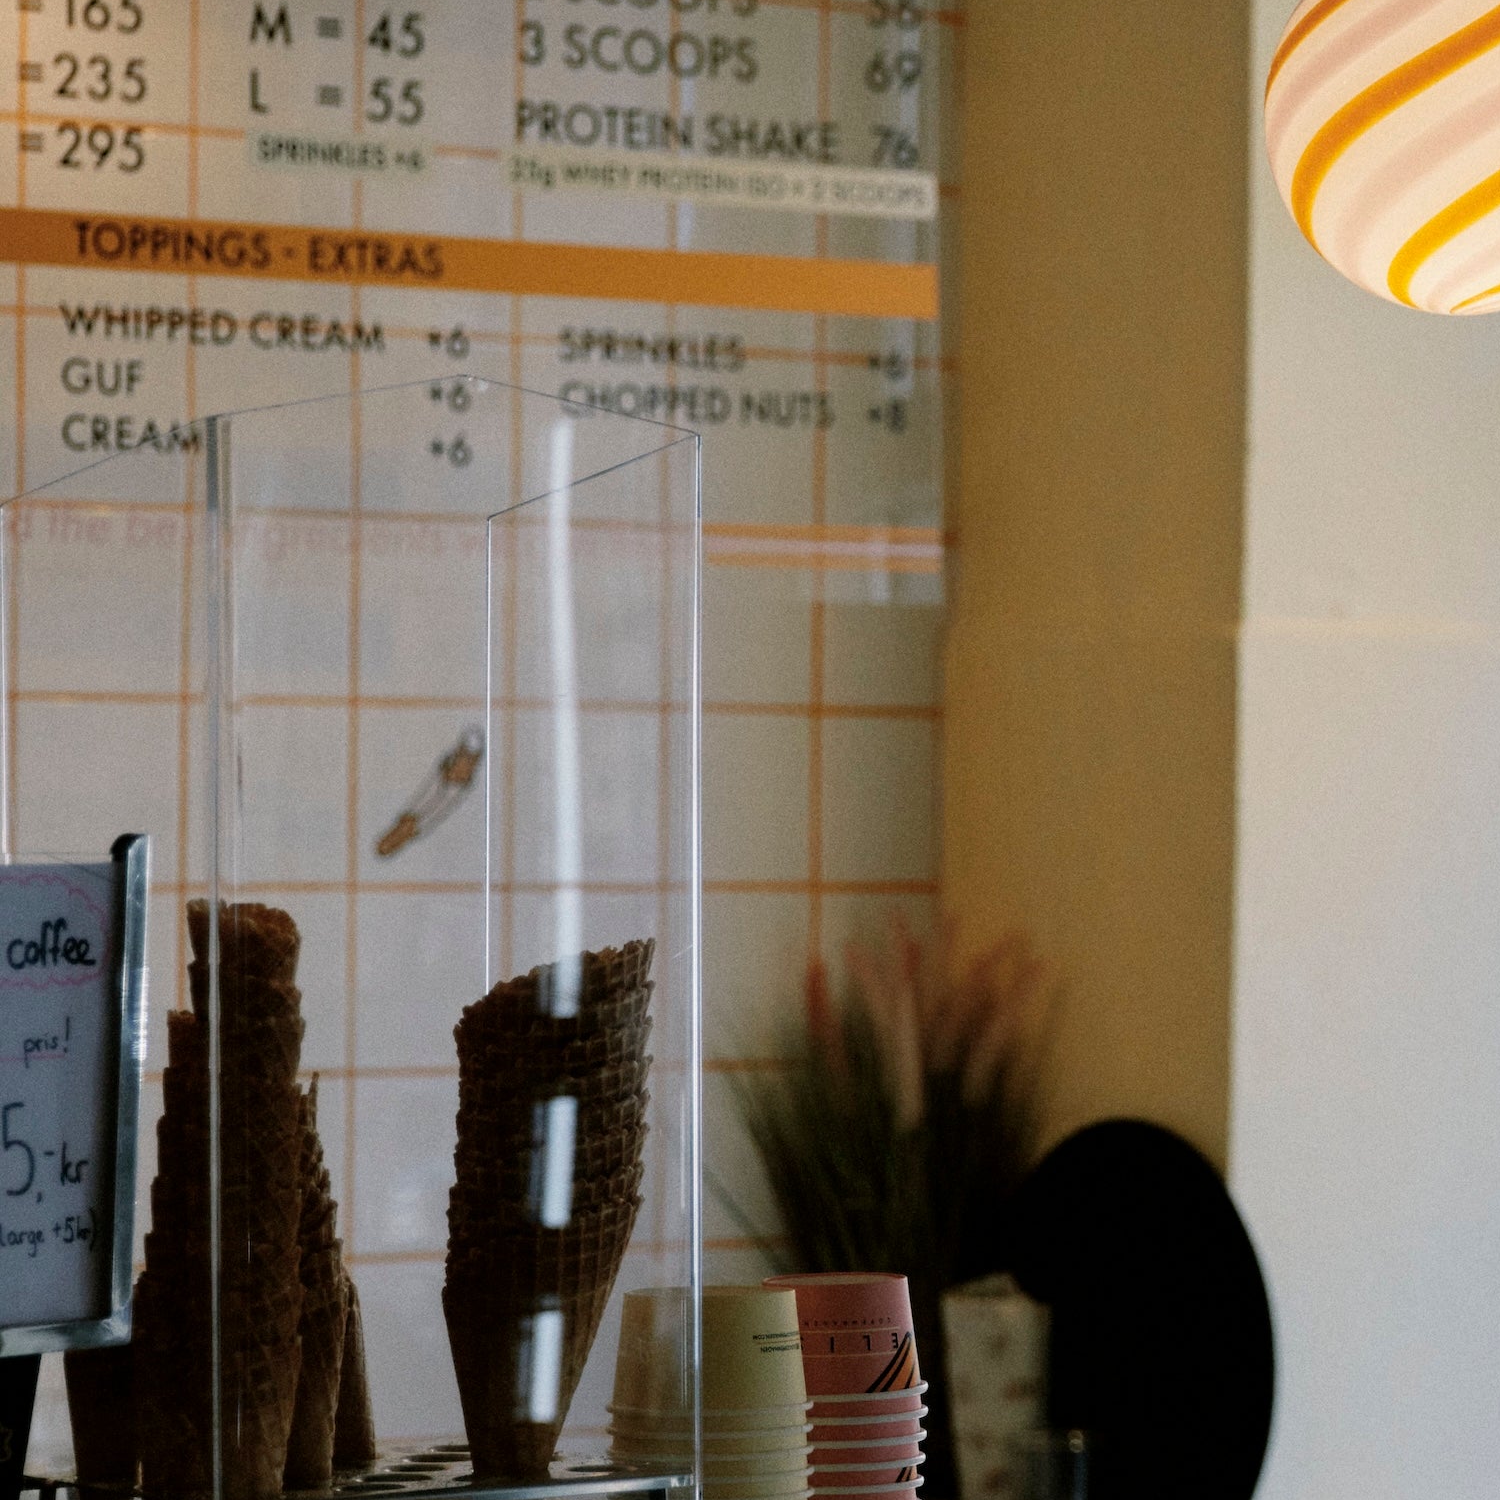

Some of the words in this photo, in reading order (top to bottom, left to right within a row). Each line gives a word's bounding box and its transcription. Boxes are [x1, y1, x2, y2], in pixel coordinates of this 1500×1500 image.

[250, 2, 292, 46] M
[368, 12, 424, 57] 45
[55, 53, 147, 103] 235
[521, 20, 545, 66] 3
[563, 23, 758, 85] SCOOPS
[865, 50, 922, 94] 69
[250, 69, 268, 115] L
[366, 78, 424, 126] 55
[57, 122, 146, 174] 295
[516, 99, 695, 152] PROTEIN
[706, 112, 840, 164] SHAKE
[74, 220, 271, 269] TOPPINGS
[308, 235, 445, 281] EXTRAS
[60, 305, 238, 347] WHIPPED
[250, 311, 387, 354] CREAM
[558, 325, 744, 373] SPRINKLES
[60, 356, 145, 397] GUF
[558, 381, 732, 426] CHOPPED
[739, 389, 836, 430] NUTS
[61, 412, 200, 456] CREAM
[6, 916, 97, 971] coffee
[23, 1015, 71, 1069] pris!
